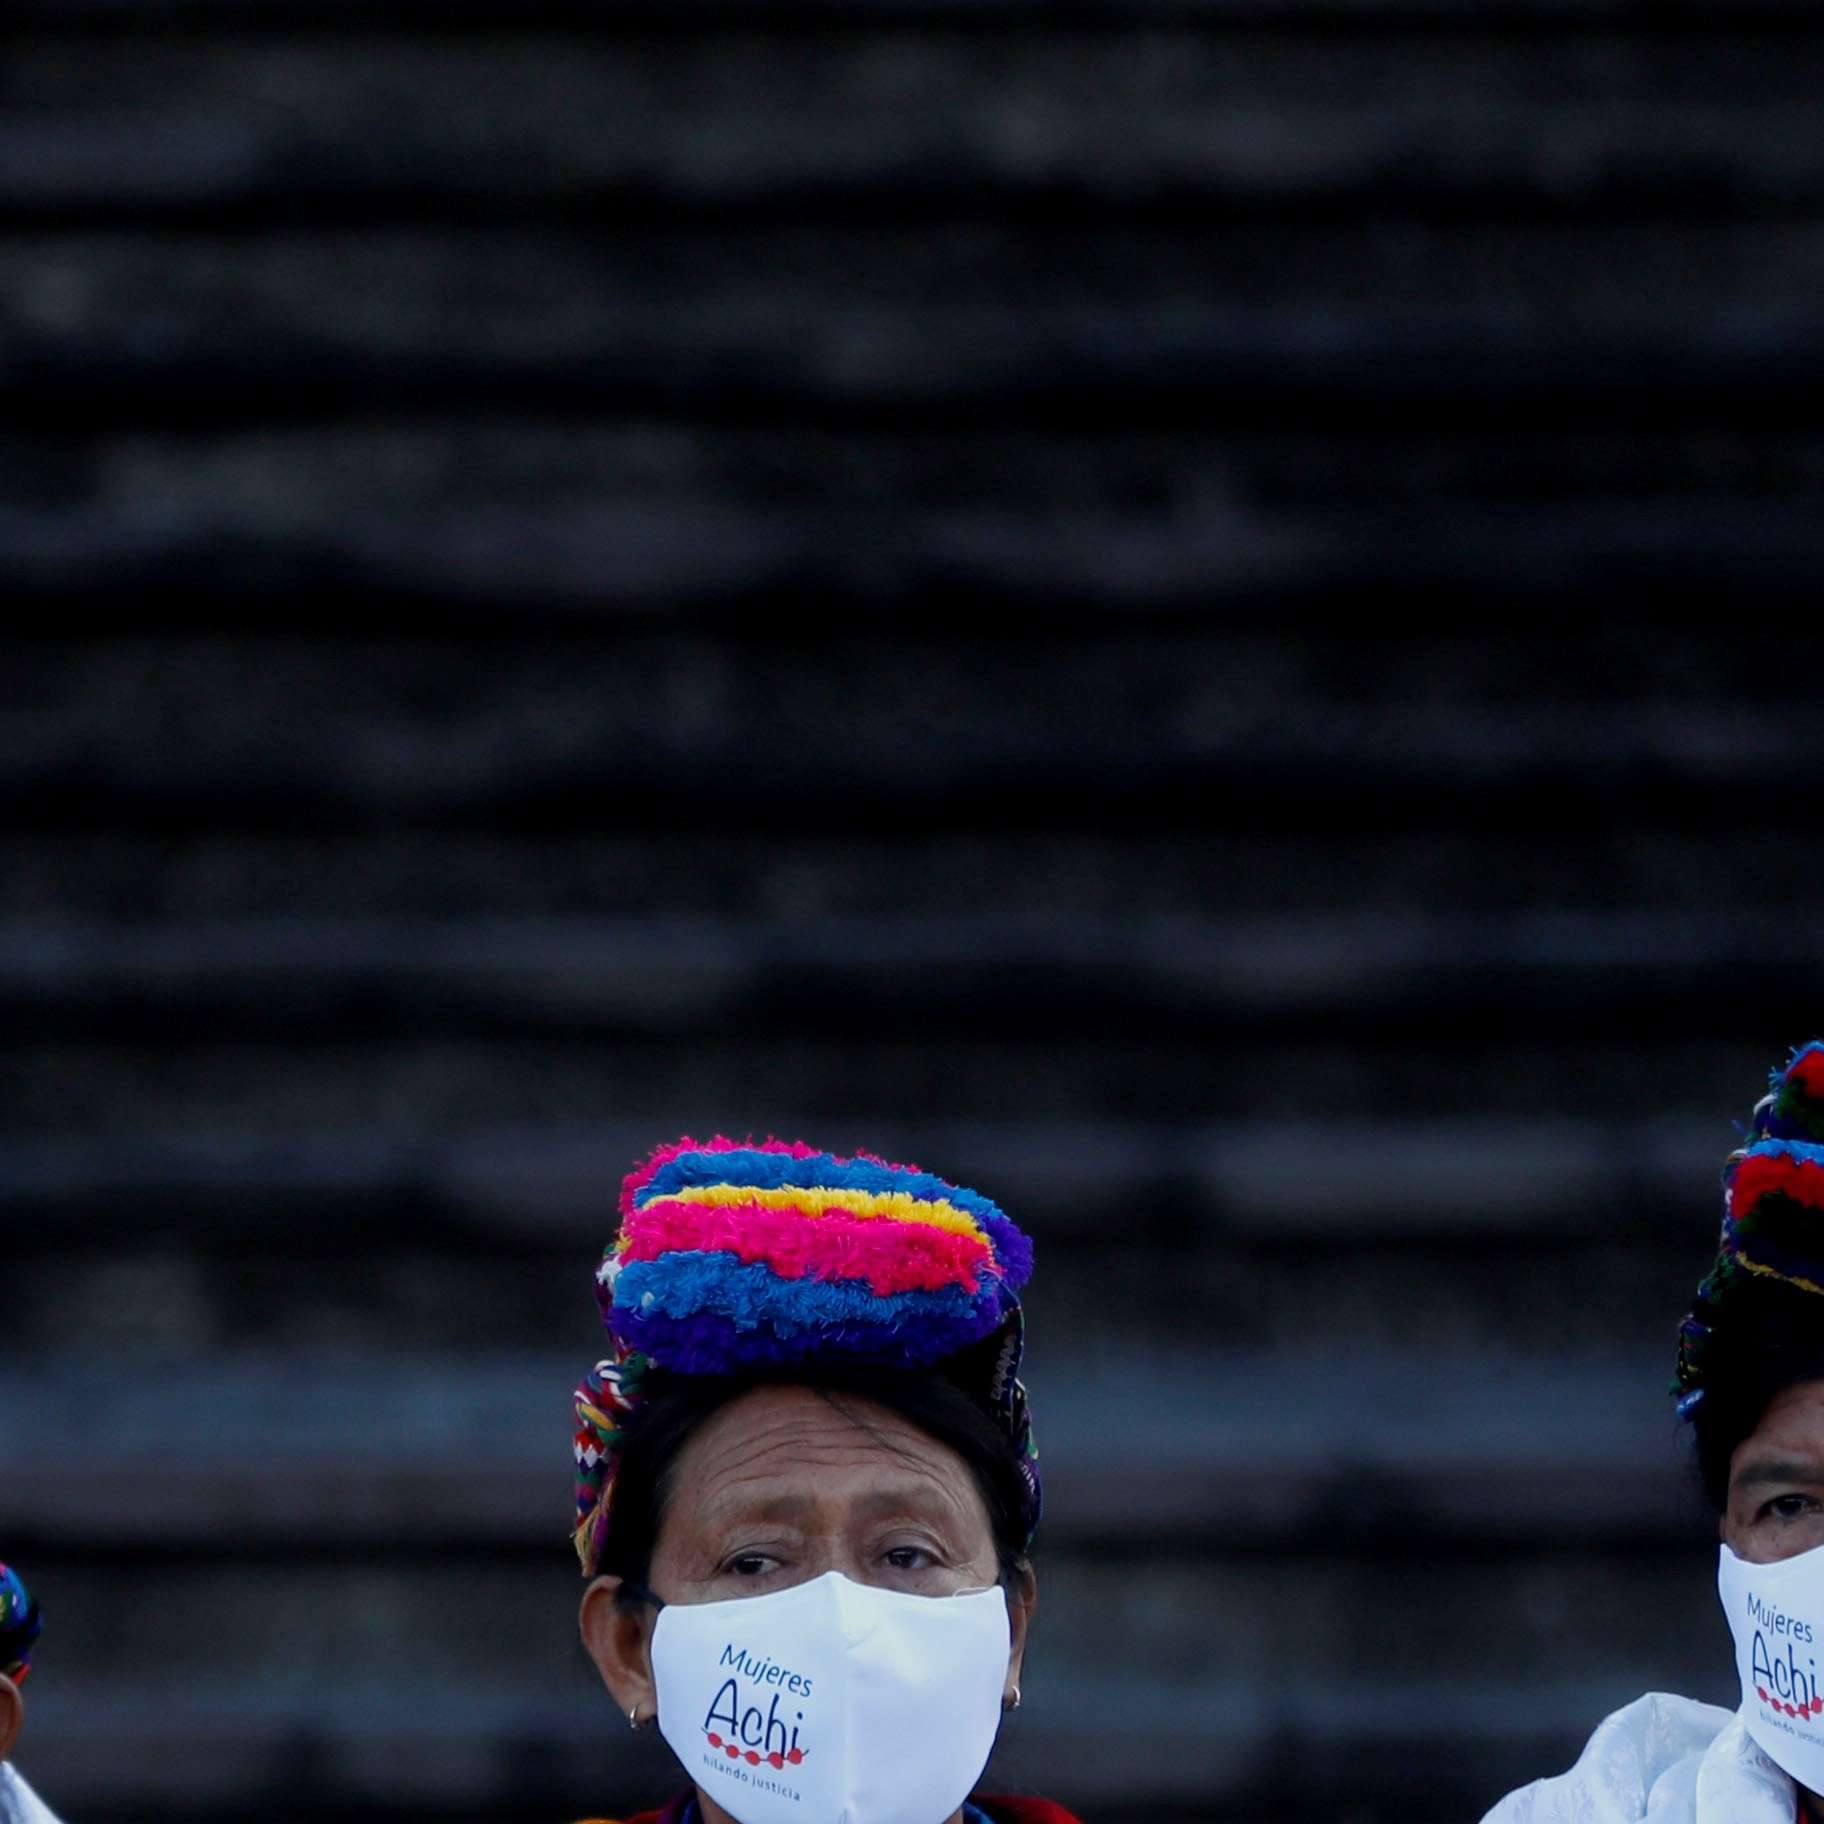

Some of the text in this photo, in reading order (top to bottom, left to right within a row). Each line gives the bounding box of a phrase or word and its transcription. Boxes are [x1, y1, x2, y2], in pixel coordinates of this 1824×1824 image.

[1747, 1592, 1813, 1644] Mujeres
[719, 1643, 813, 1698] Mujeres
[1752, 1630, 1816, 1710] Achi
[704, 1678, 803, 1760] Achi
[703, 1754, 801, 1801] hilando justicia
